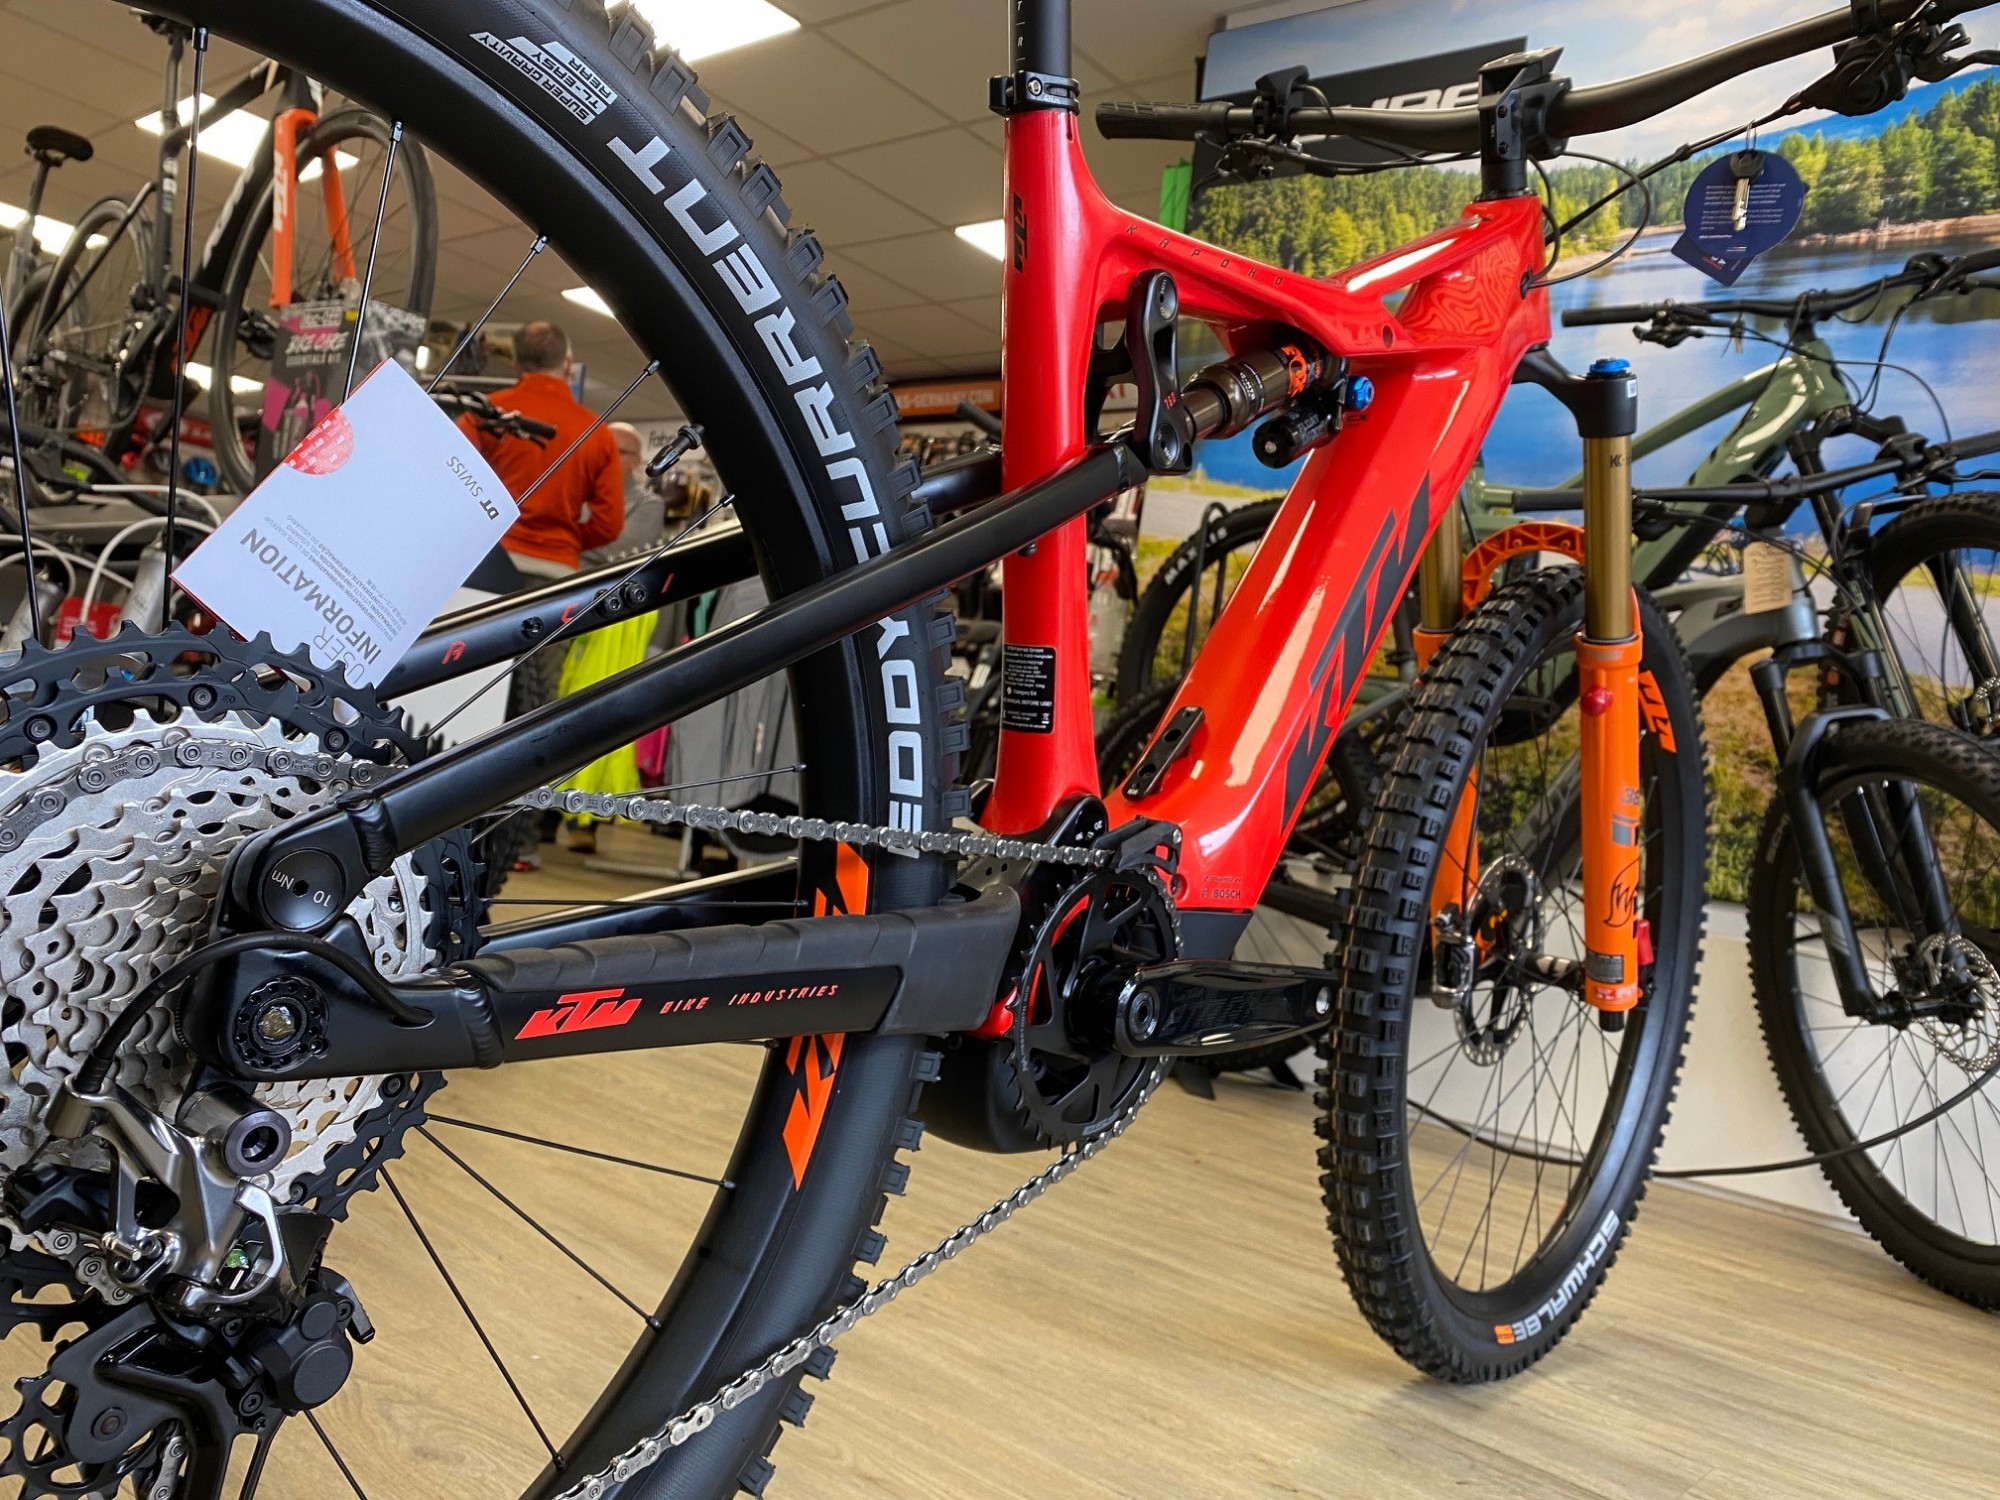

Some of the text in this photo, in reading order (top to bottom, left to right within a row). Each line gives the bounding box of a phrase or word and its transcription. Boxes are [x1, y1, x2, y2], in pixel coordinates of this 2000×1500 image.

[478, 35, 590, 121] SUPER GRAVITY
[530, 51, 601, 110] TL-EASY
[567, 59, 612, 99] REAR
[445, 455, 499, 520] DT SWISS
[1163, 526, 1228, 586] MAXIS
[238, 526, 381, 665] INFORMATION
[369, 604, 398, 636] INFORMAZIONI
[310, 625, 366, 683] USER
[877, 617, 923, 859] EDDY
[271, 869, 331, 907] 10 Nm
[1213, 888, 1241, 900] BOSCH
[514, 984, 839, 1040] KTM BIKE INDUSTRIES
[1511, 1209, 1621, 1342] SCHWALBE
